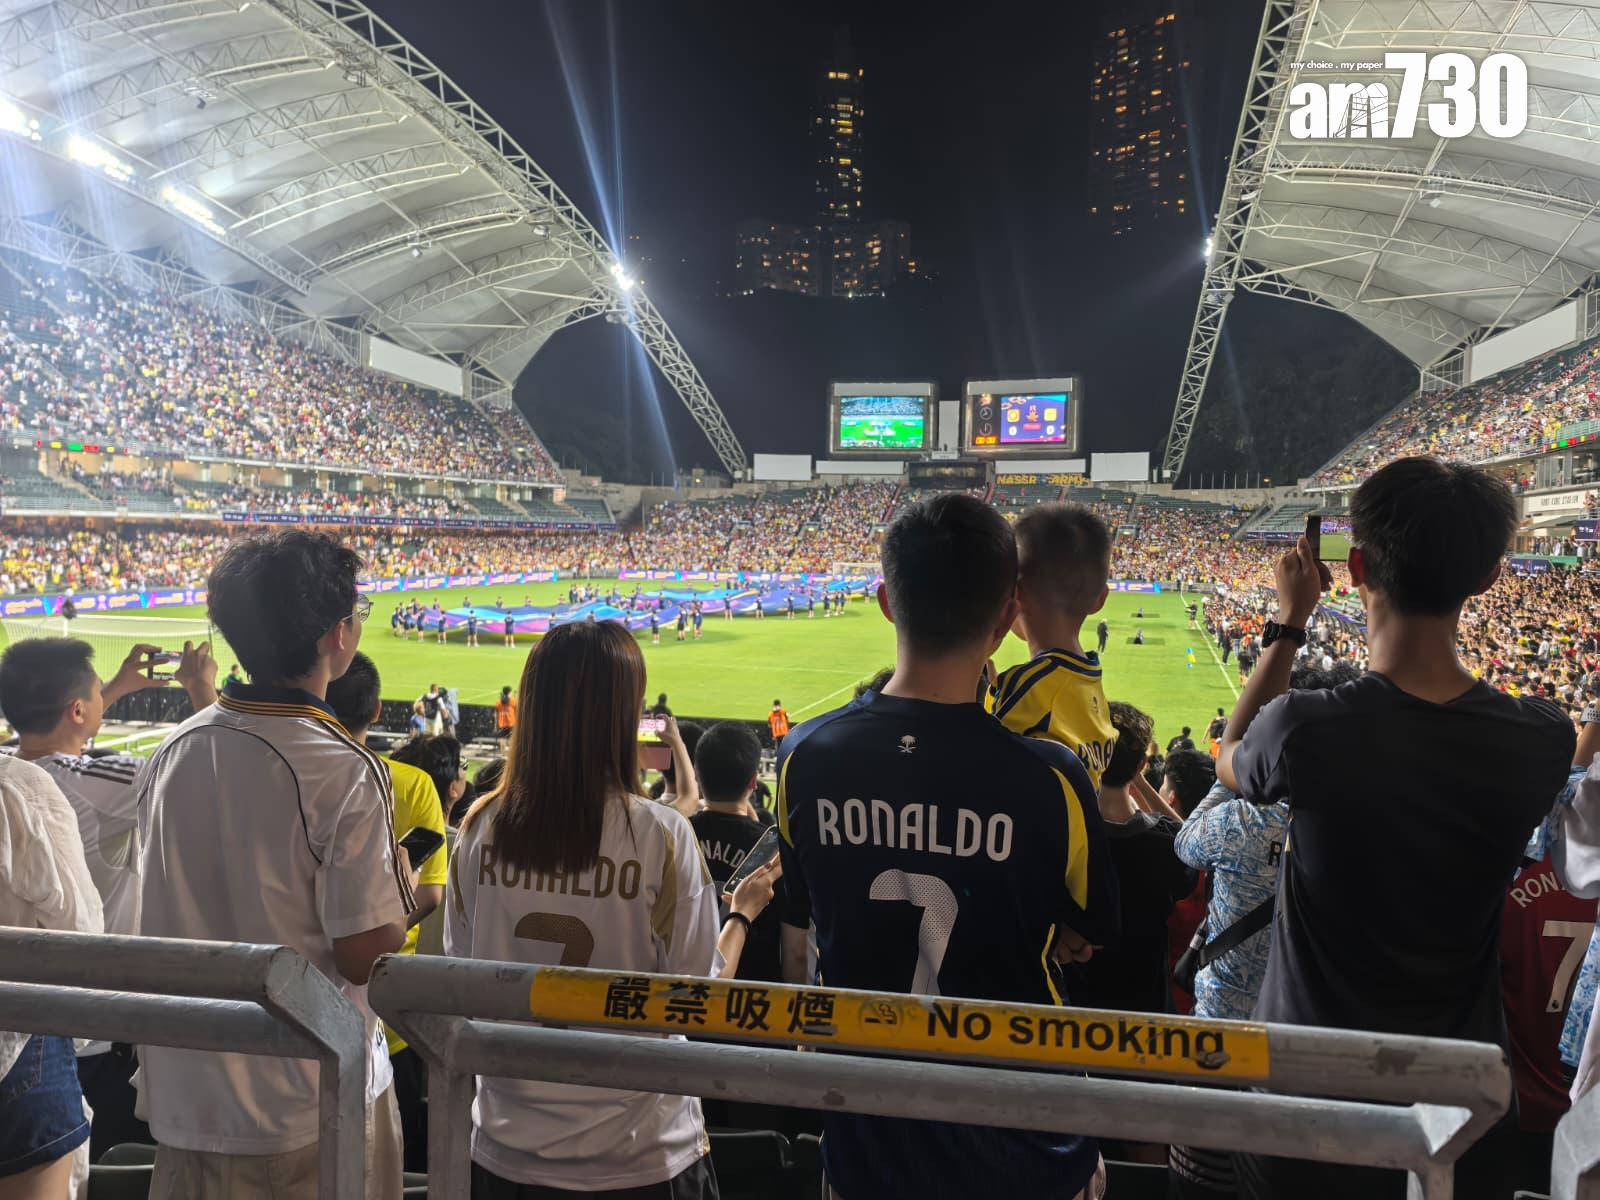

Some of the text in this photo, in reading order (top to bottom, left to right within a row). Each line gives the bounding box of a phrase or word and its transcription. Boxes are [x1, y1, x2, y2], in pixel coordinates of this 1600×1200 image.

[997, 474, 1037, 485] NASSR
[817, 798, 1014, 862] RONALDO
[1510, 871, 1566, 908] RON
[868, 868, 959, 996] 7
[1541, 919, 1596, 1013] 7
[603, 976, 837, 1037] 嚴禁吸煙
[927, 1003, 1225, 1071] No smoking
